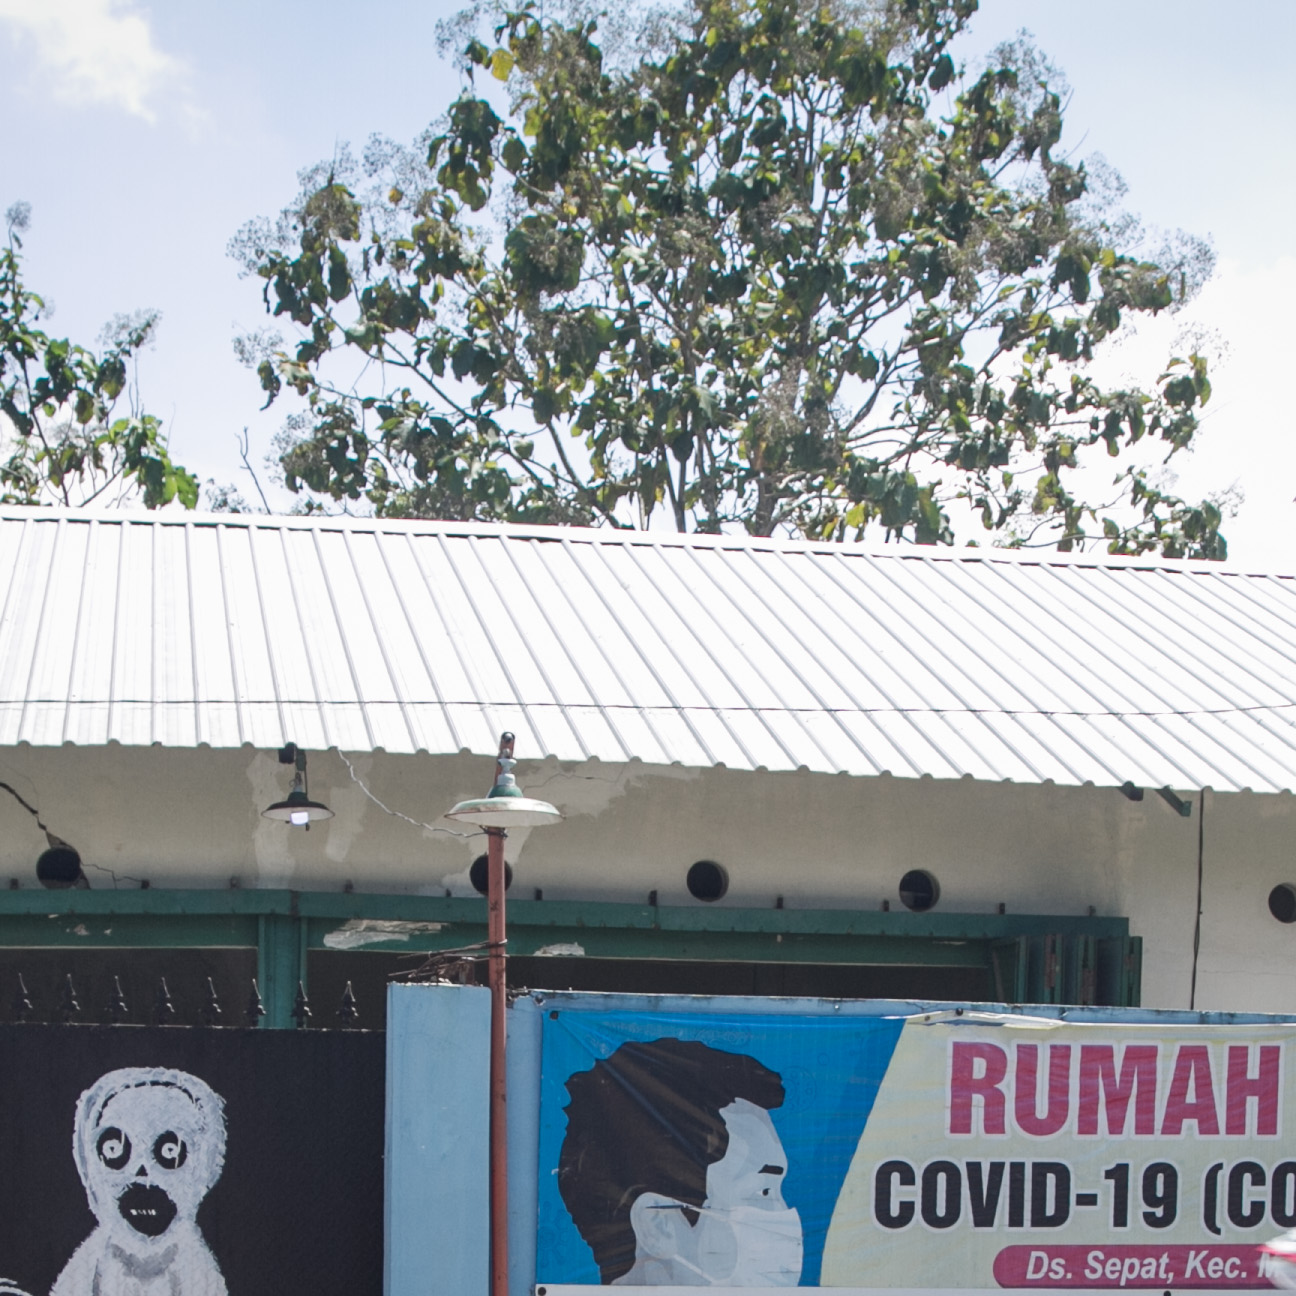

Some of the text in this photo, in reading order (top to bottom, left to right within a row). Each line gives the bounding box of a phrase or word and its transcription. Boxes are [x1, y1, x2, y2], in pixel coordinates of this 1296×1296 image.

[950, 1041, 1281, 1135] RUMAH
[874, 1160, 1178, 1228] COVID-19
[1026, 1250, 1072, 1280] Ds.
[1084, 1250, 1174, 1286] Sepat,
[1184, 1250, 1247, 1279] Kec.
